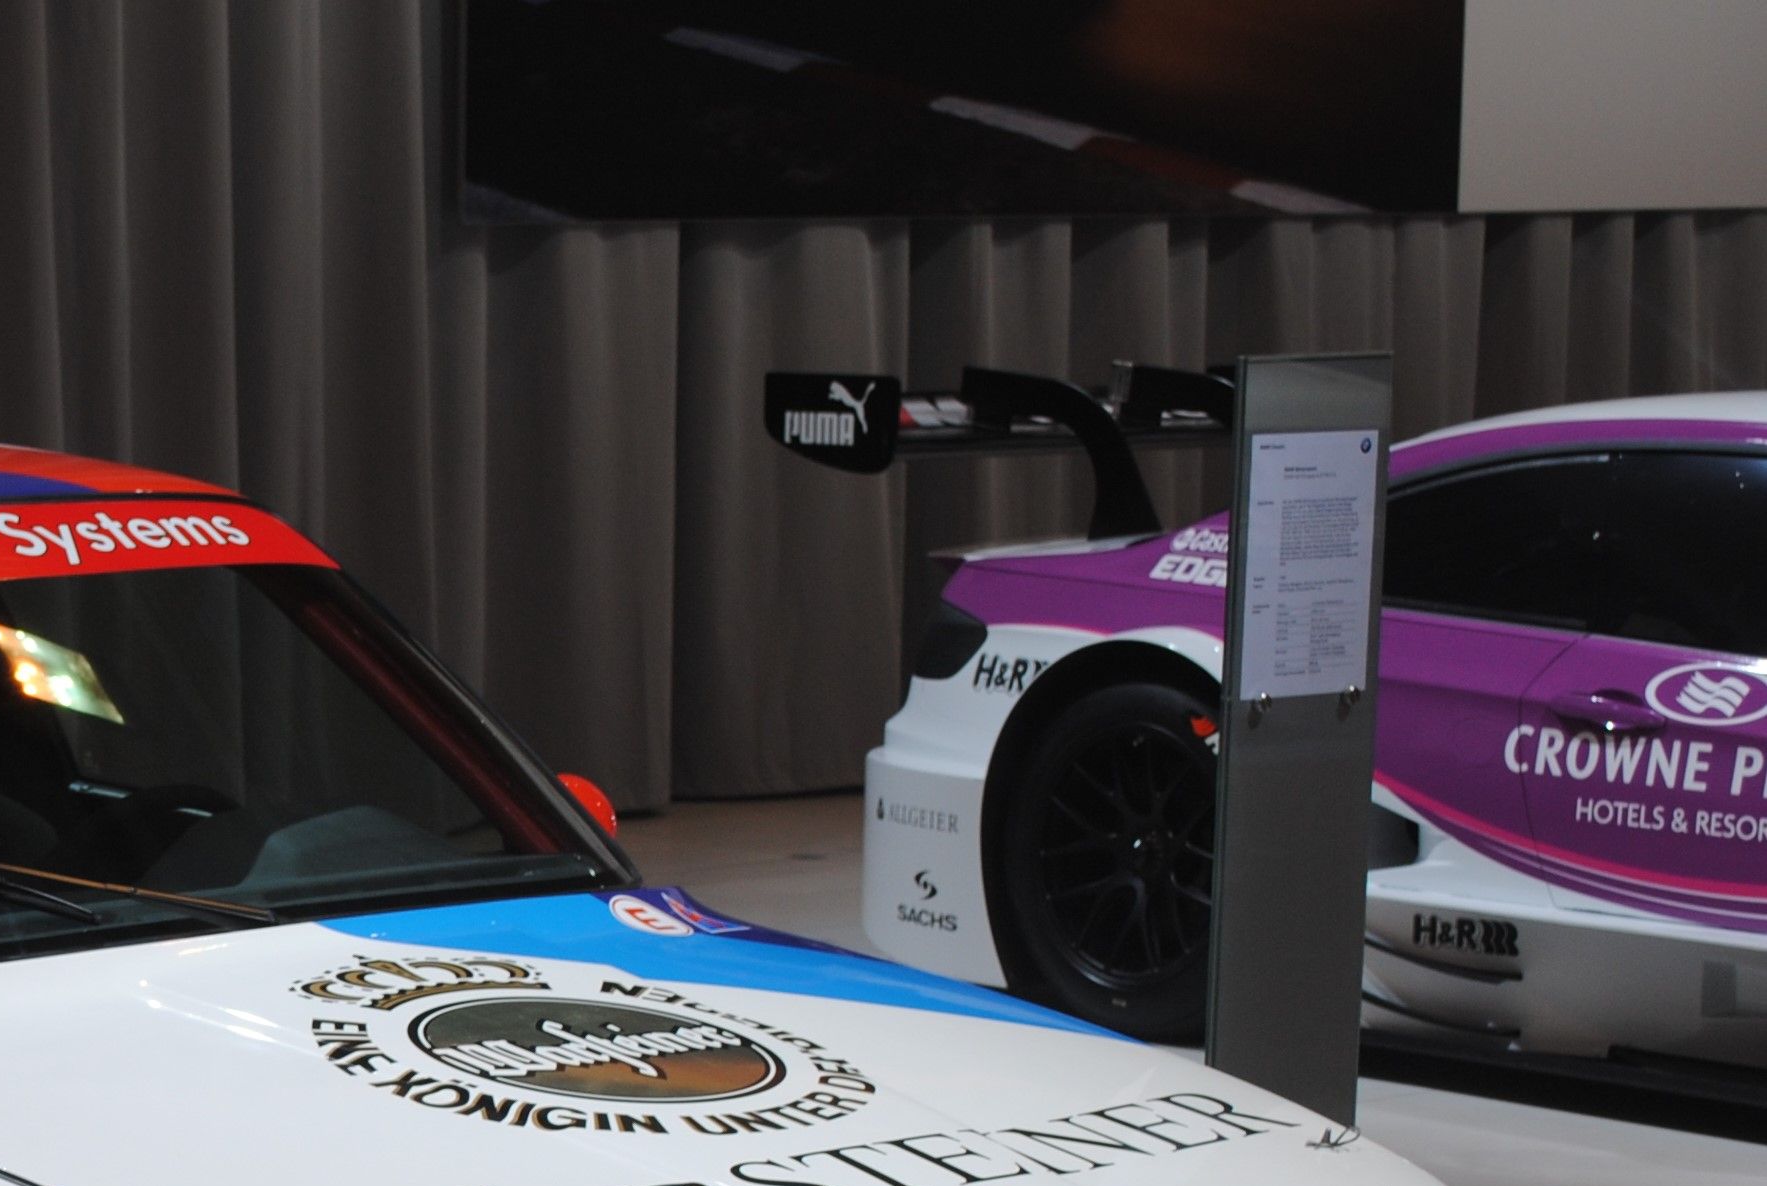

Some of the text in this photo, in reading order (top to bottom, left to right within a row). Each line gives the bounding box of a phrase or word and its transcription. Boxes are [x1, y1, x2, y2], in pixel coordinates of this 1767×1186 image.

[784, 411, 854, 446] PUMA
[1149, 553, 1228, 587] EDG
[1504, 724, 1713, 793] CROWNE
[1576, 798, 1664, 831] HOTELS
[1670, 808, 1687, 834] &
[897, 903, 958, 932] SACHS
[311, 1018, 392, 1077] EINE
[371, 1070, 670, 1136] KÖNIGIN
[681, 1091, 868, 1136] UNTER
